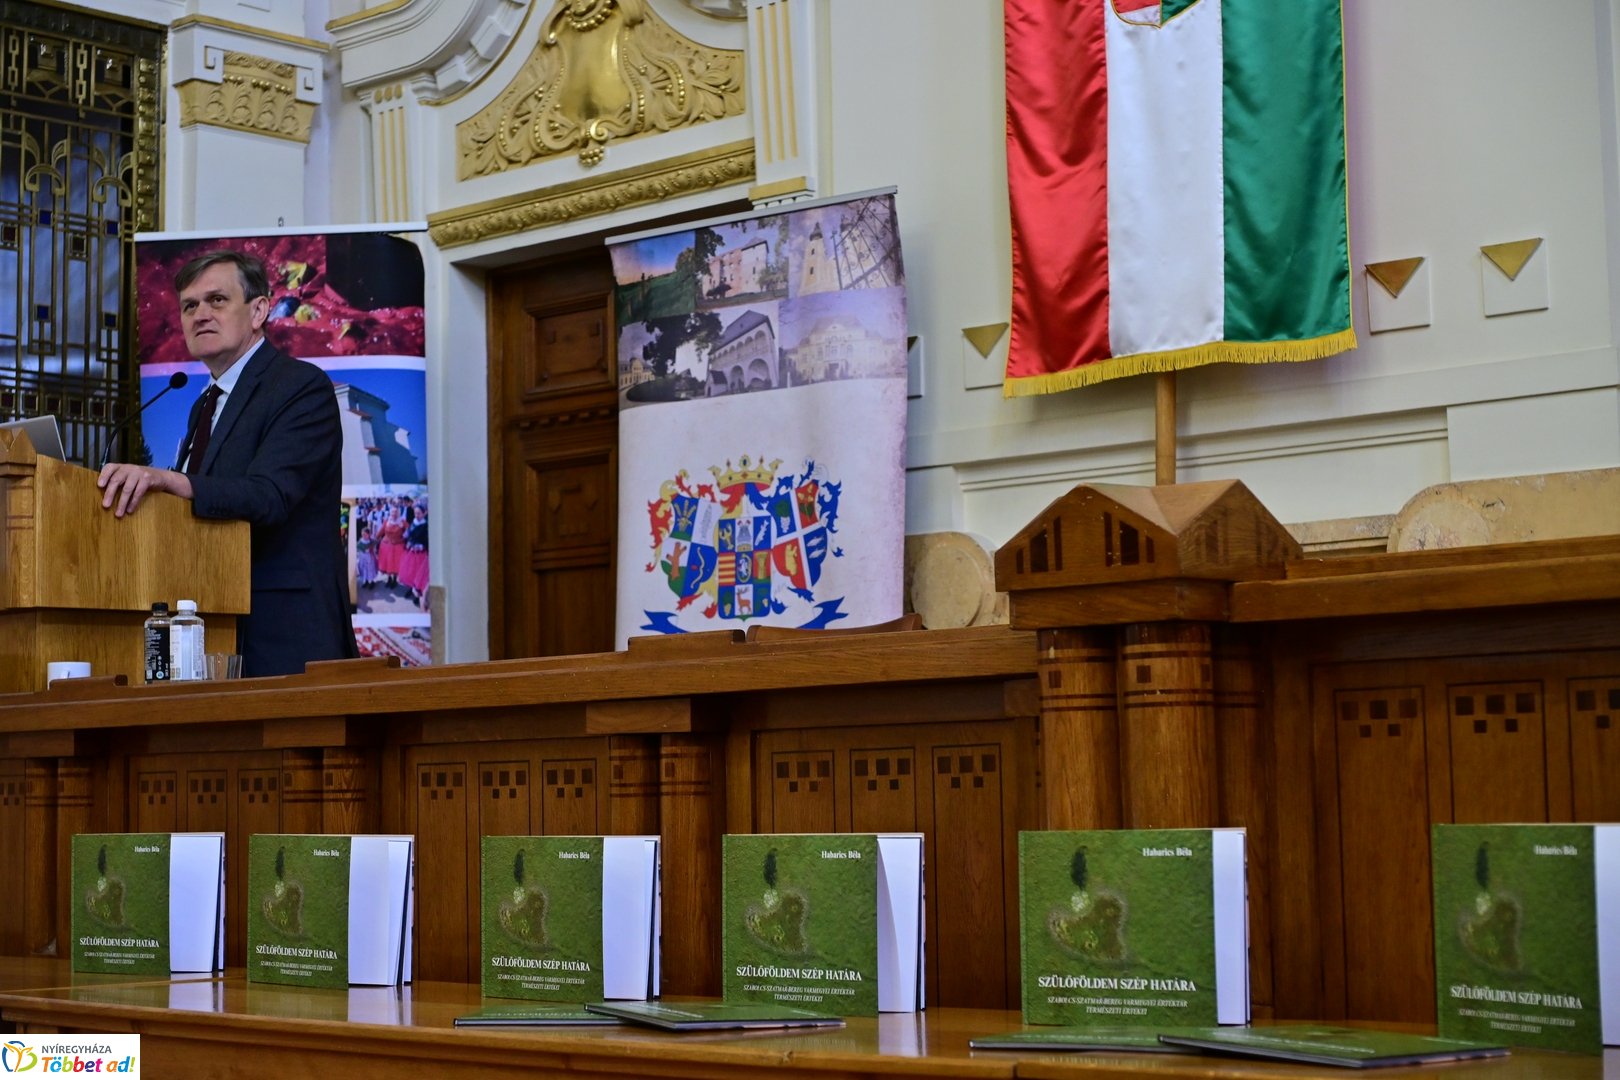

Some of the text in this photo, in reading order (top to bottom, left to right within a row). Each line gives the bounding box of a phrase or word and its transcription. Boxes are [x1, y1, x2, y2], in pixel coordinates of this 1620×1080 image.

[121, 937, 136, 947] SZÉP
[298, 947, 313, 958] SZÉP
[314, 948, 338, 960] HATÁRA
[542, 958, 561, 970] SZÉP
[562, 960, 590, 972] HATÁRA
[802, 967, 824, 980] SZÉP
[826, 968, 862, 981] HATÁRA
[1120, 976, 1148, 990] SZÉP
[1150, 977, 1196, 992] HATÁRA
[1519, 990, 1542, 1005] SZÉP
[1542, 993, 1583, 1009] HATÁRA
